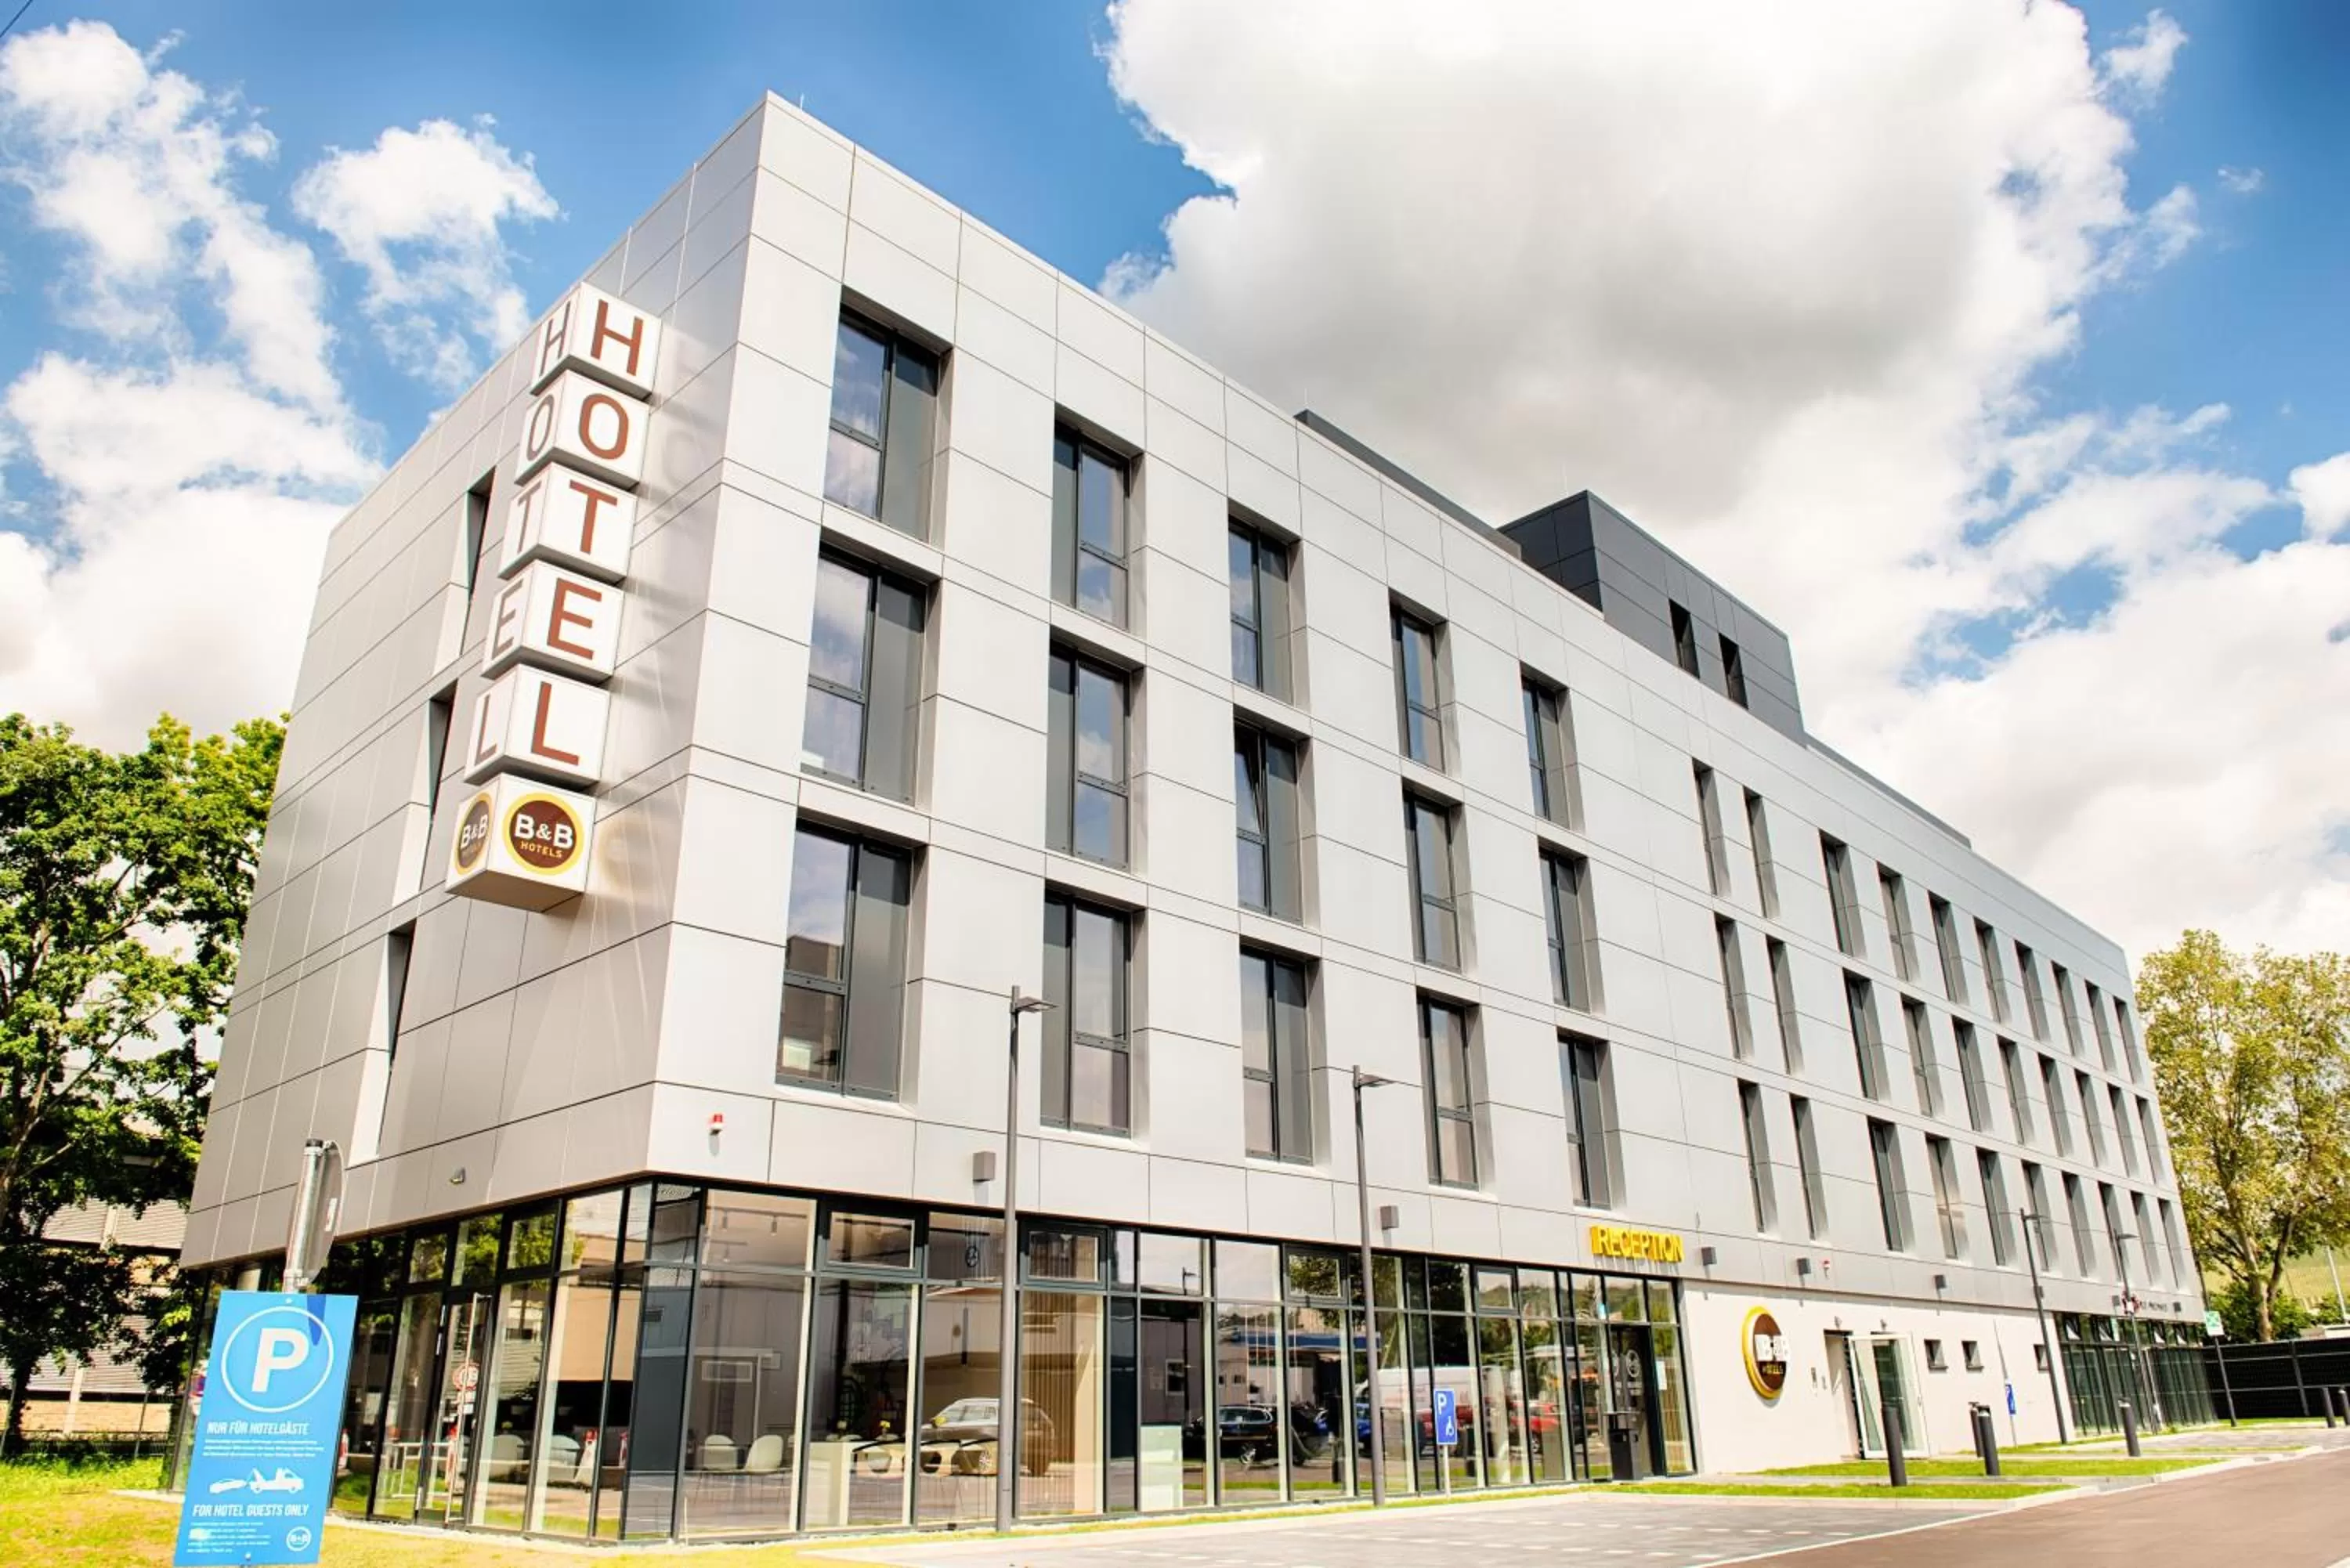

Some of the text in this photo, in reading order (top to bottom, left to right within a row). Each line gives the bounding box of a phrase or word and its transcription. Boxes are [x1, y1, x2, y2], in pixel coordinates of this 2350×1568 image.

[475, 301, 572, 767] HOTEL
[530, 300, 644, 766] HOTEL
[515, 813, 573, 849] B&B
[520, 840, 563, 859] HOTELS
[1591, 1226, 1684, 1263] RECEPTION
[251, 1328, 309, 1393] P
[1437, 1393, 1447, 1415] P
[206, 1419, 310, 1435] NUR FÜR HOTELGÄSTE
[192, 1504, 309, 1517] FOR HOTEL GUESTS ONLY
